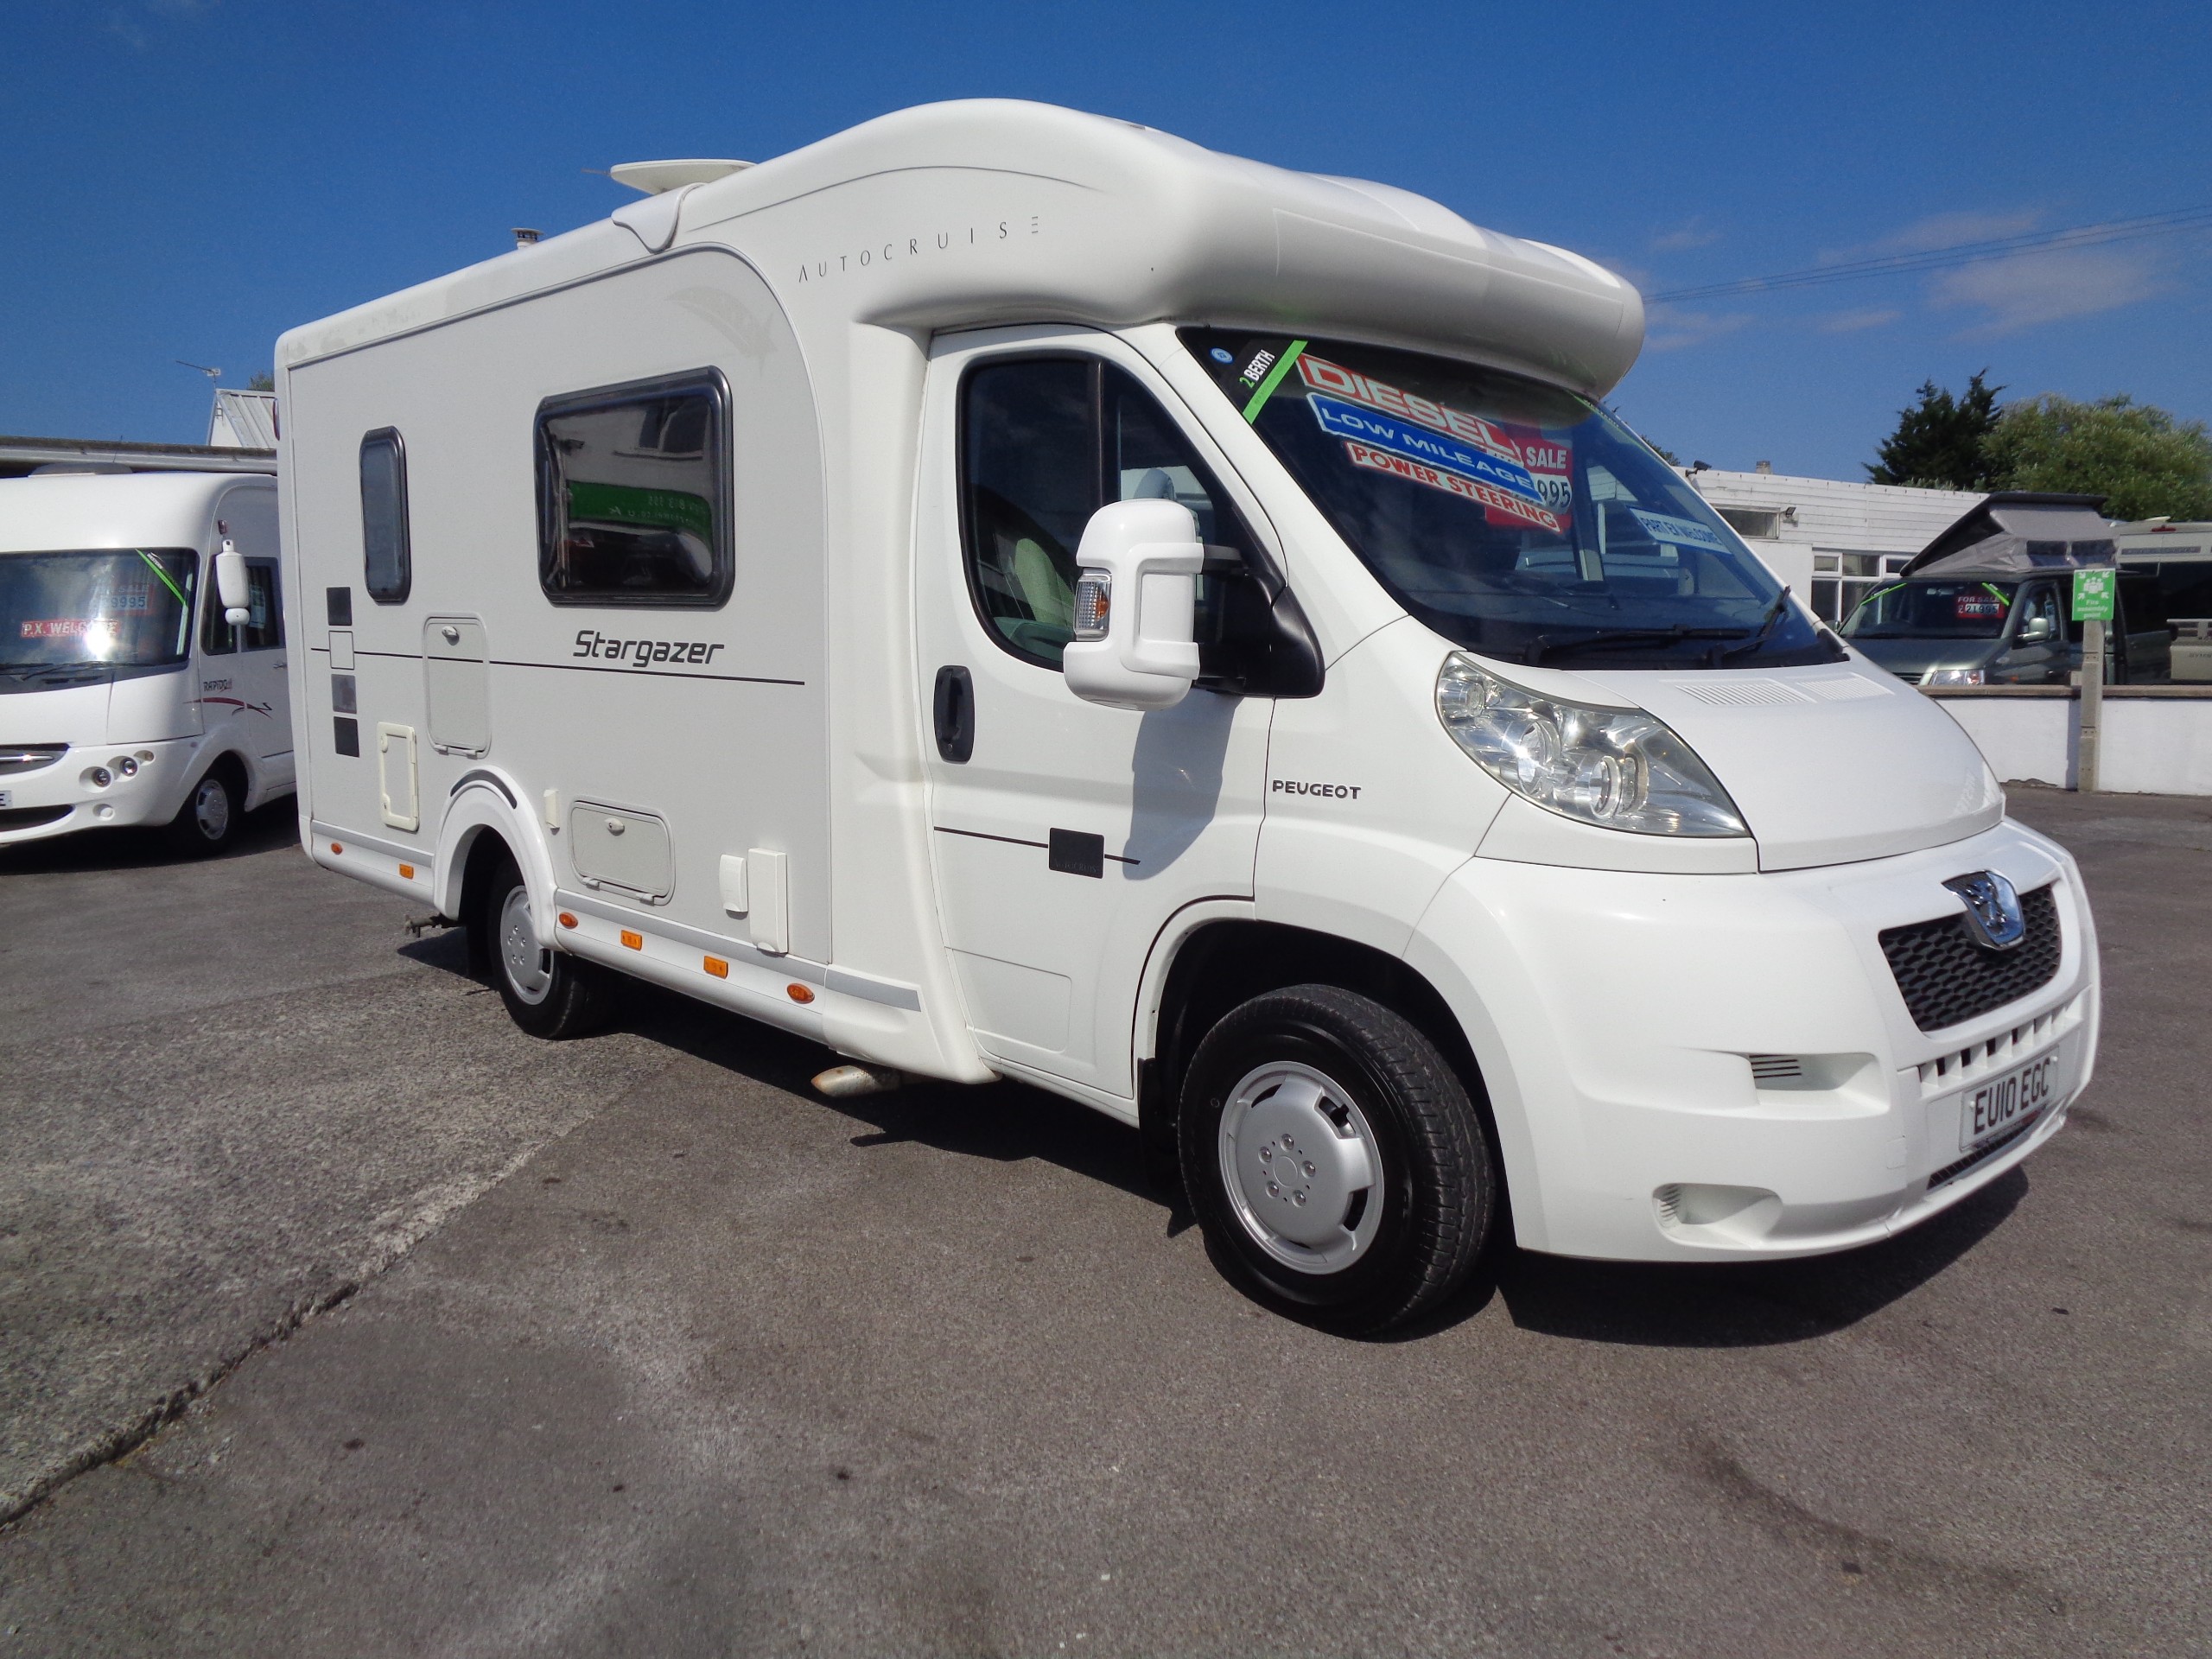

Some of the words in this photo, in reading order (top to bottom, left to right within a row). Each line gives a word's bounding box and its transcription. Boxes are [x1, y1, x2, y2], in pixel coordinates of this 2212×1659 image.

[798, 216, 1039, 283] AUTOCRUISE
[1239, 376, 1255, 389] 2
[1243, 349, 1275, 382] BERTH
[1304, 357, 1516, 456] DIESEL
[1321, 407, 1395, 440] LOW
[1402, 433, 1535, 490] MILEAGE
[1526, 446, 1567, 469] SALE
[1351, 444, 1443, 486] POWER
[1446, 475, 1558, 529] STEERING
[572, 630, 725, 668] Stargazer
[1272, 779, 1362, 800] PEUGEOT
[1974, 1076, 2017, 1135] EU10
[2020, 1057, 2050, 1111] EGC
